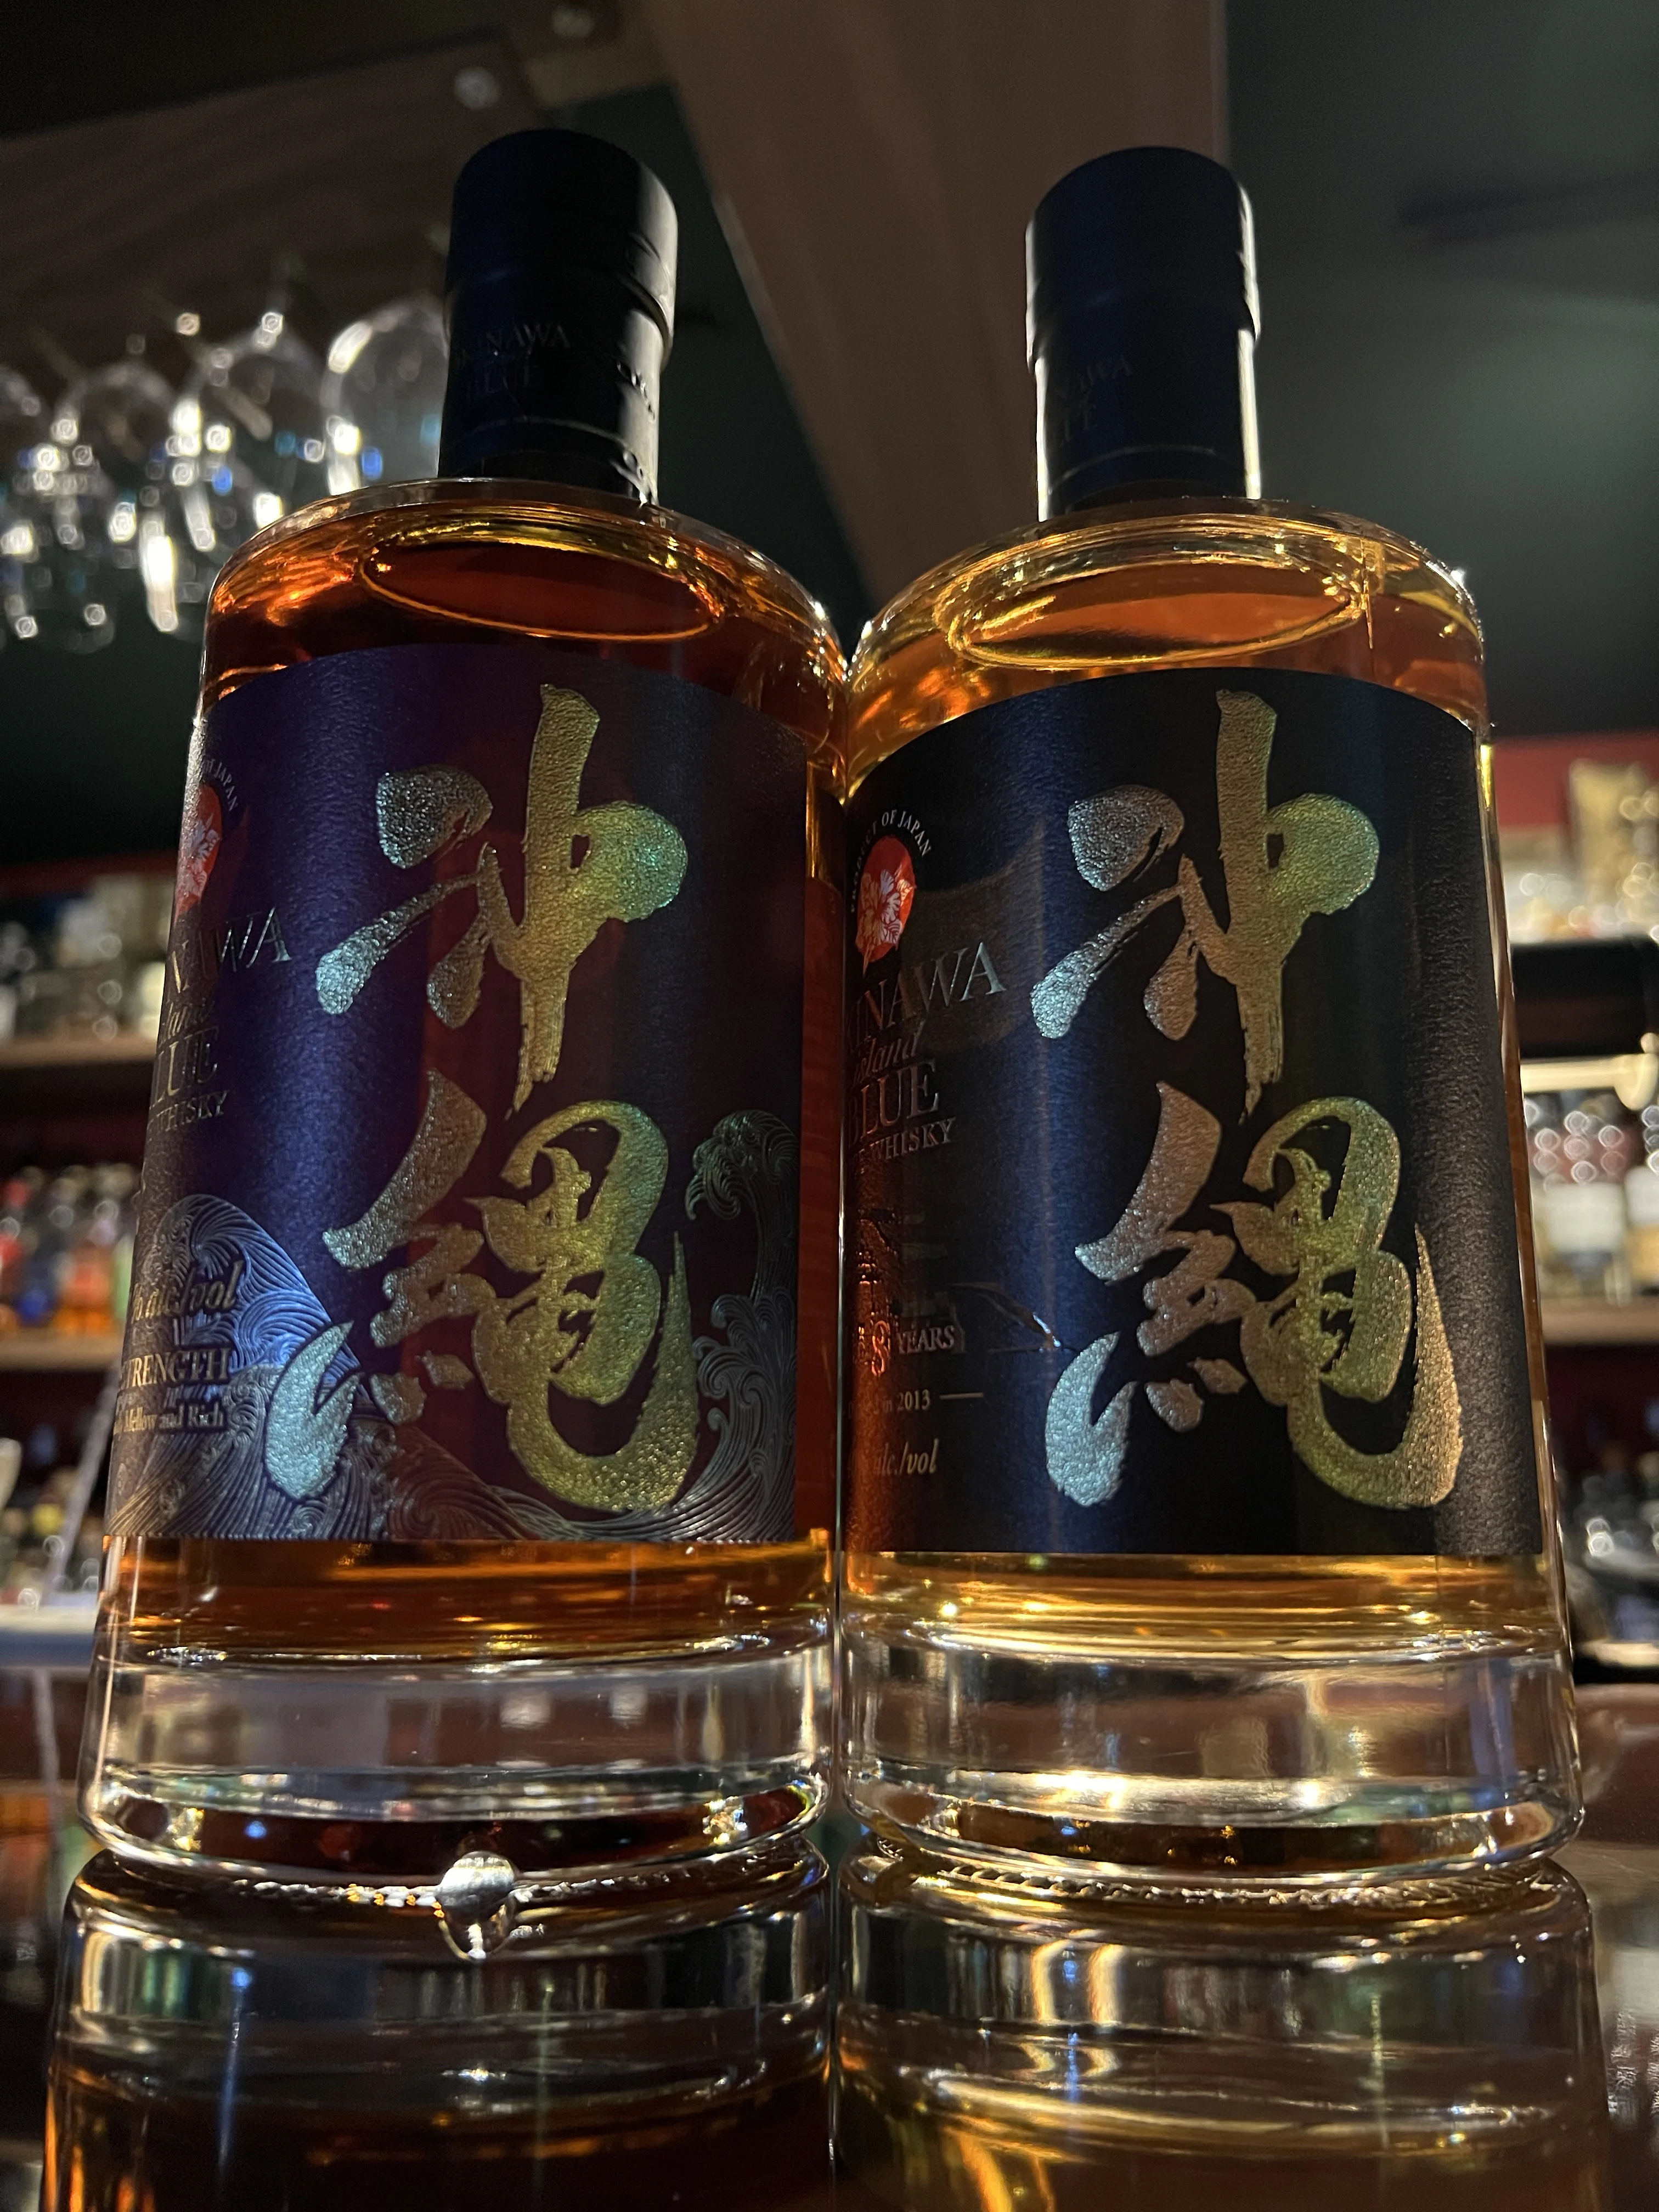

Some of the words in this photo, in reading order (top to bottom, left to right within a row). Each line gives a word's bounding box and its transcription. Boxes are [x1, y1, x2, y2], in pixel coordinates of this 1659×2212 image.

[881, 809, 898, 827] OF
[897, 810, 932, 857] JAPAN
[870, 1116, 957, 1162] WHISKY
[897, 1324, 956, 1355] YEARS
[897, 1388, 932, 1412] 2013
